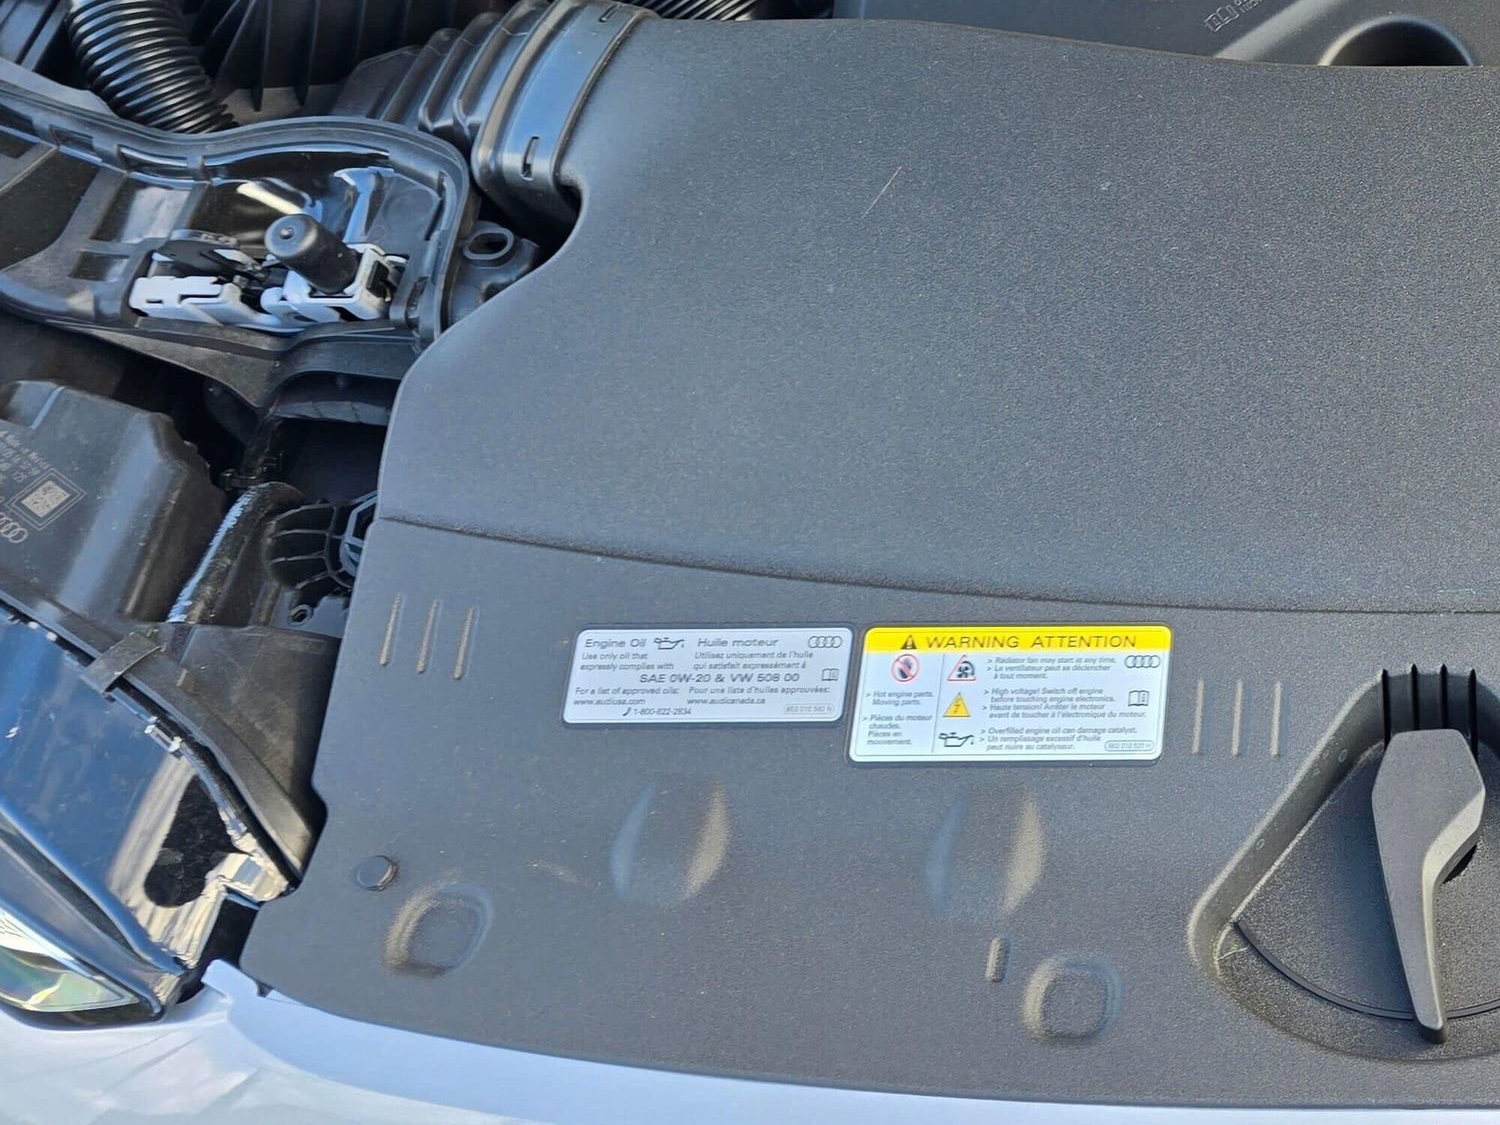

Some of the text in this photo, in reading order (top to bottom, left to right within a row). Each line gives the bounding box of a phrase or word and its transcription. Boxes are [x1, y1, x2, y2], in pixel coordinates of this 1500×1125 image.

[585, 639, 647, 649] Engine Oil
[697, 638, 779, 647] Huile moteur
[926, 635, 1138, 648] WARNING ATTENTION
[600, 653, 617, 661] only
[695, 651, 725, 659] Utilisez
[726, 651, 775, 660] uniquement
[1085, 657, 1098, 665] any
[580, 664, 618, 672] expressly
[619, 663, 655, 671] complies
[693, 662, 706, 670] qui
[742, 662, 799, 670] expressément
[640, 673, 800, 683] SAE 0W-20 & VW 508 00
[622, 687, 661, 695] approved
[728, 686, 745, 694] liste
[991, 687, 1103, 696] High voltage! Switch off engine
[888, 691, 912, 699] engine
[990, 695, 1012, 703] before
[1016, 695, 1047, 703] touching
[686, 697, 766, 705] www.audicanada.ca
[872, 699, 921, 707] Moving parts.
[1077, 727, 1106, 735] damage
[1000, 735, 1044, 743] remplissage
[1036, 743, 1074, 751] catalyseur.
